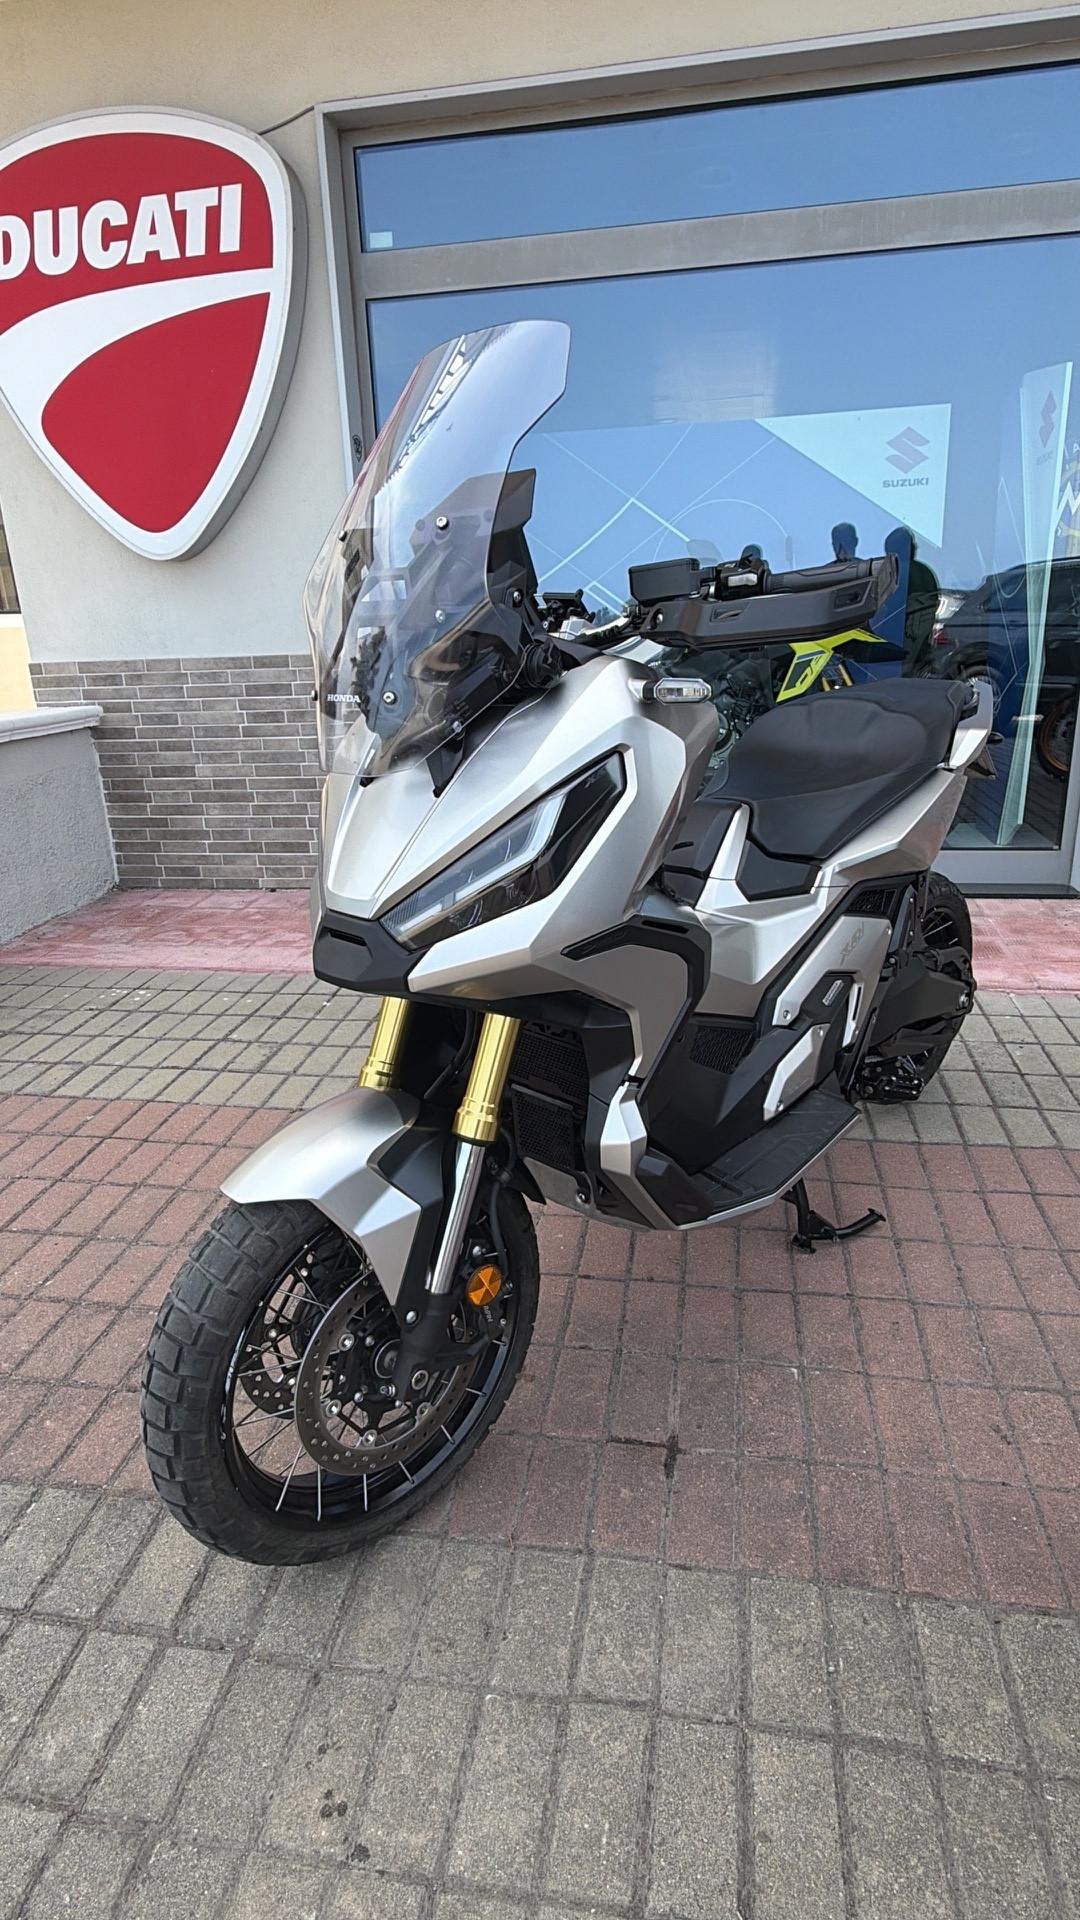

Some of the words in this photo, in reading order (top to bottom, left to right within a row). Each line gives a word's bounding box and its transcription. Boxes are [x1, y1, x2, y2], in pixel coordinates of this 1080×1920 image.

[0, 183, 242, 280] DUCATI
[882, 477, 929, 488] SUZUKI
[327, 694, 361, 703] HONDA
